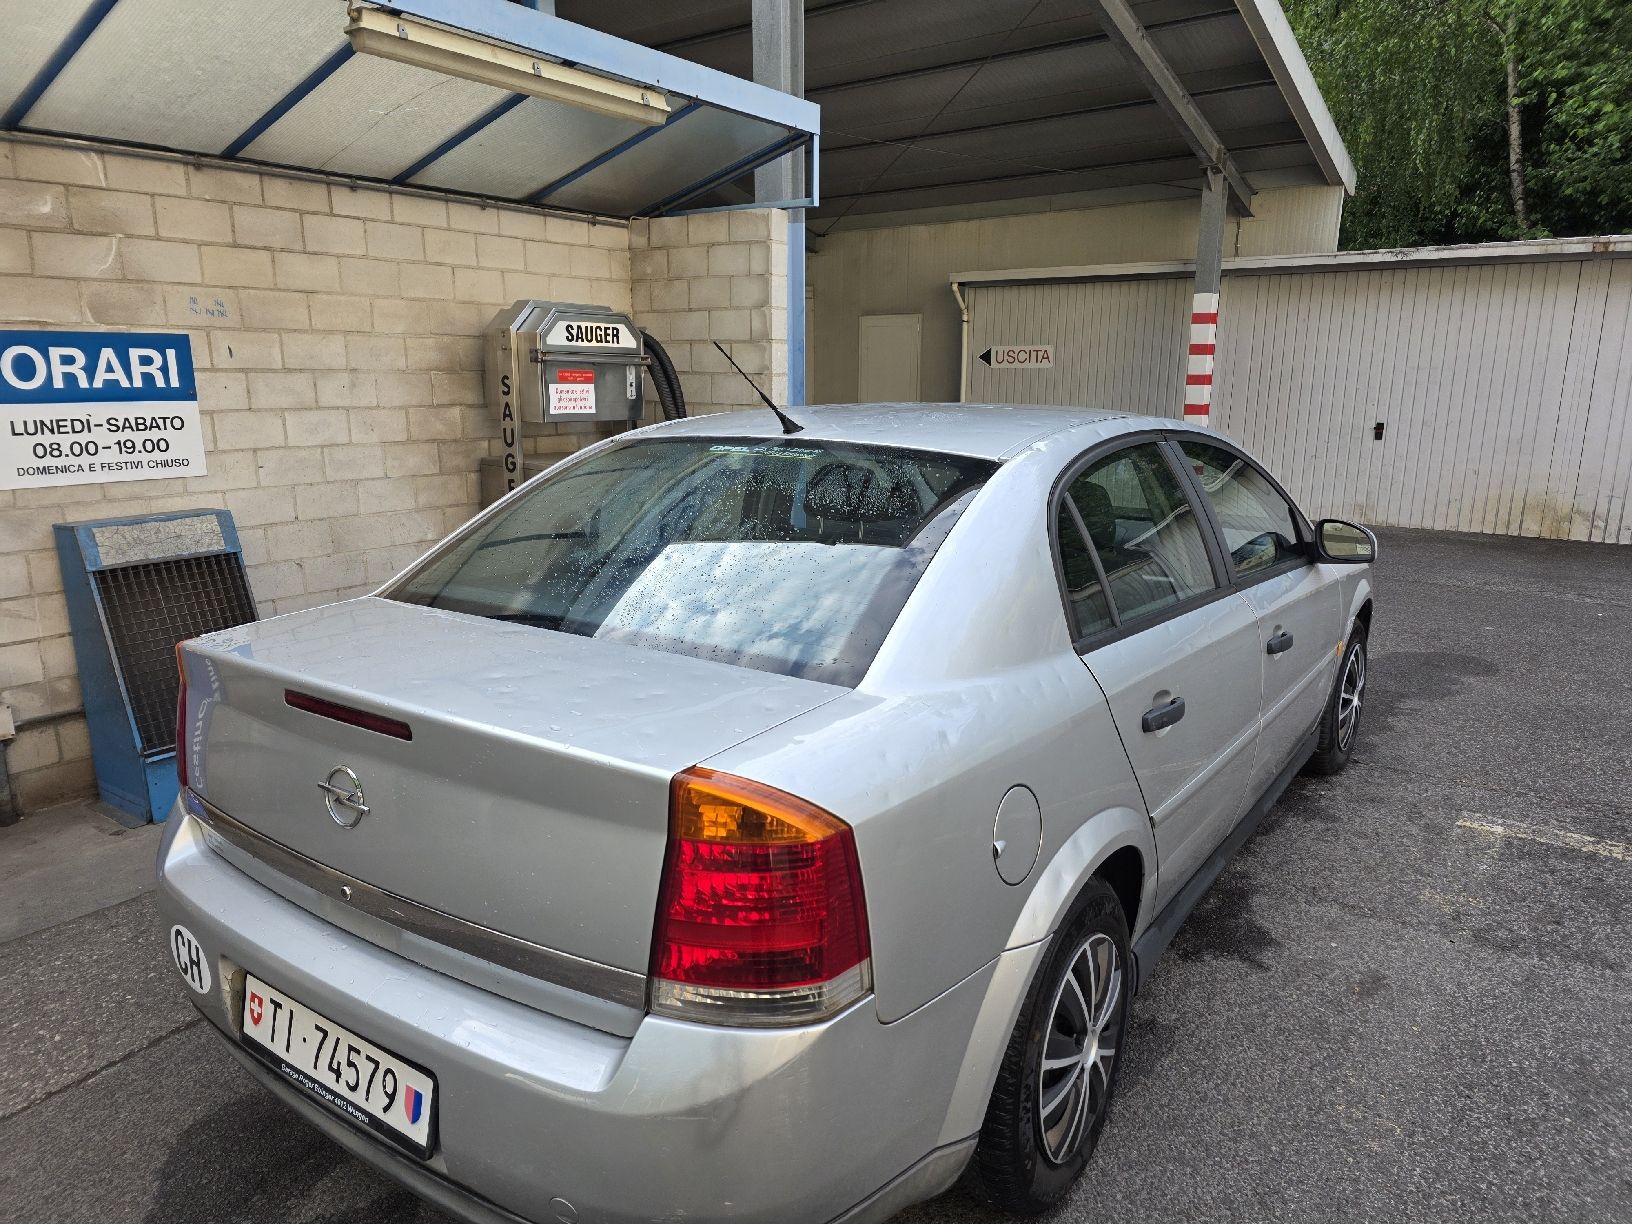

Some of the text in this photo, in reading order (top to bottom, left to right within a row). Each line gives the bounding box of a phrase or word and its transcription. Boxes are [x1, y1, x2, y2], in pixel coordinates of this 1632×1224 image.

[565, 324, 620, 344] SAUGER
[995, 349, 1051, 364] USCITA
[0, 345, 180, 390] ORARI
[17, 458, 190, 477] DOMENICA E FESTIVI CHIUSO
[174, 928, 204, 990] CH
